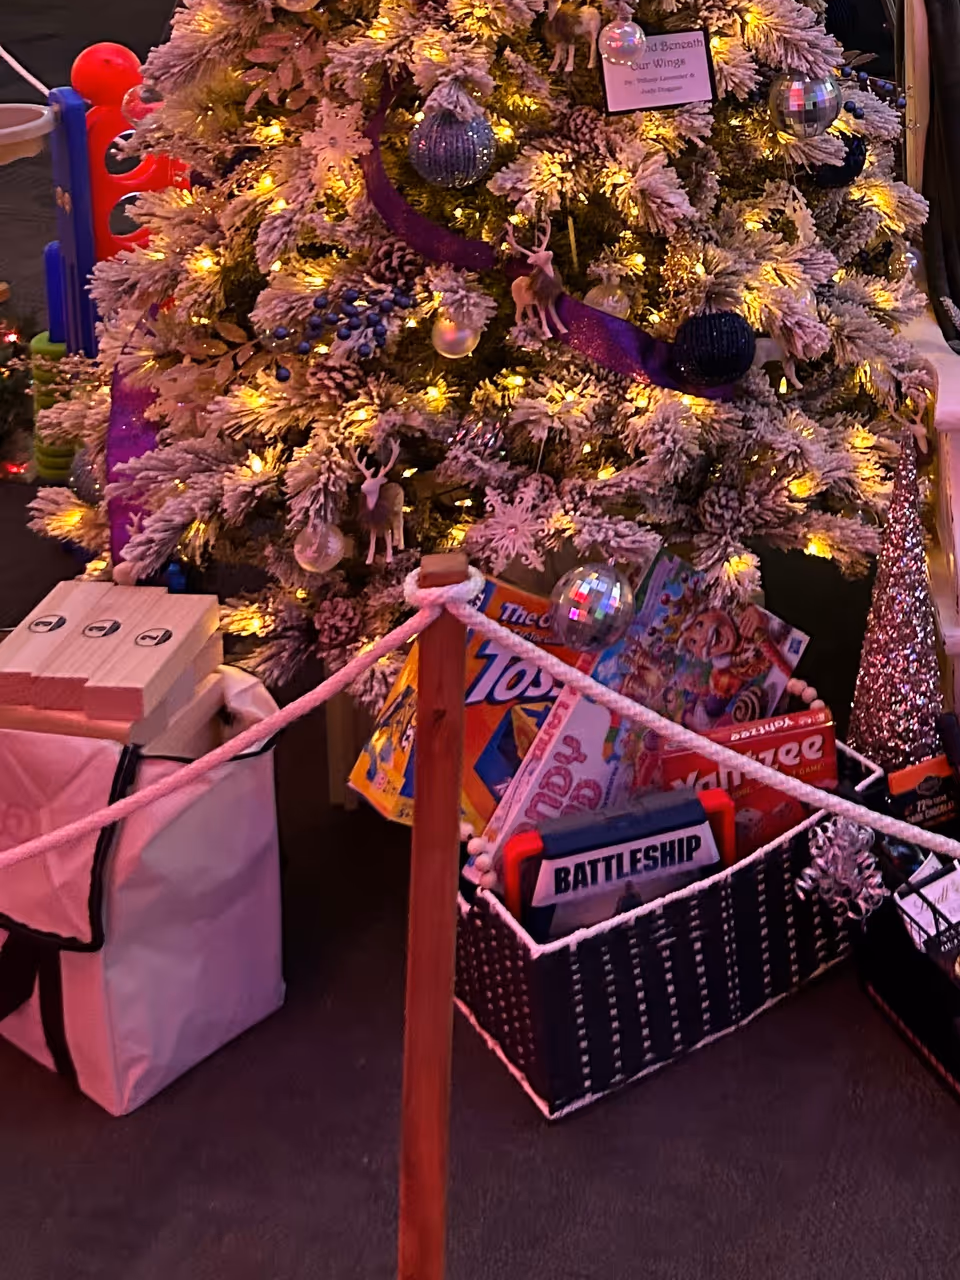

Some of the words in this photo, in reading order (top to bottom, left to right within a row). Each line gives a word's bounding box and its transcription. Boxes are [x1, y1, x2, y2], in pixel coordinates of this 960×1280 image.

[661, 37, 703, 52] Beneath
[653, 56, 687, 69] Wings
[500, 602, 536, 626] The
[730, 717, 793, 741] Yahtzee
[554, 834, 702, 896] BATTLESHIP
